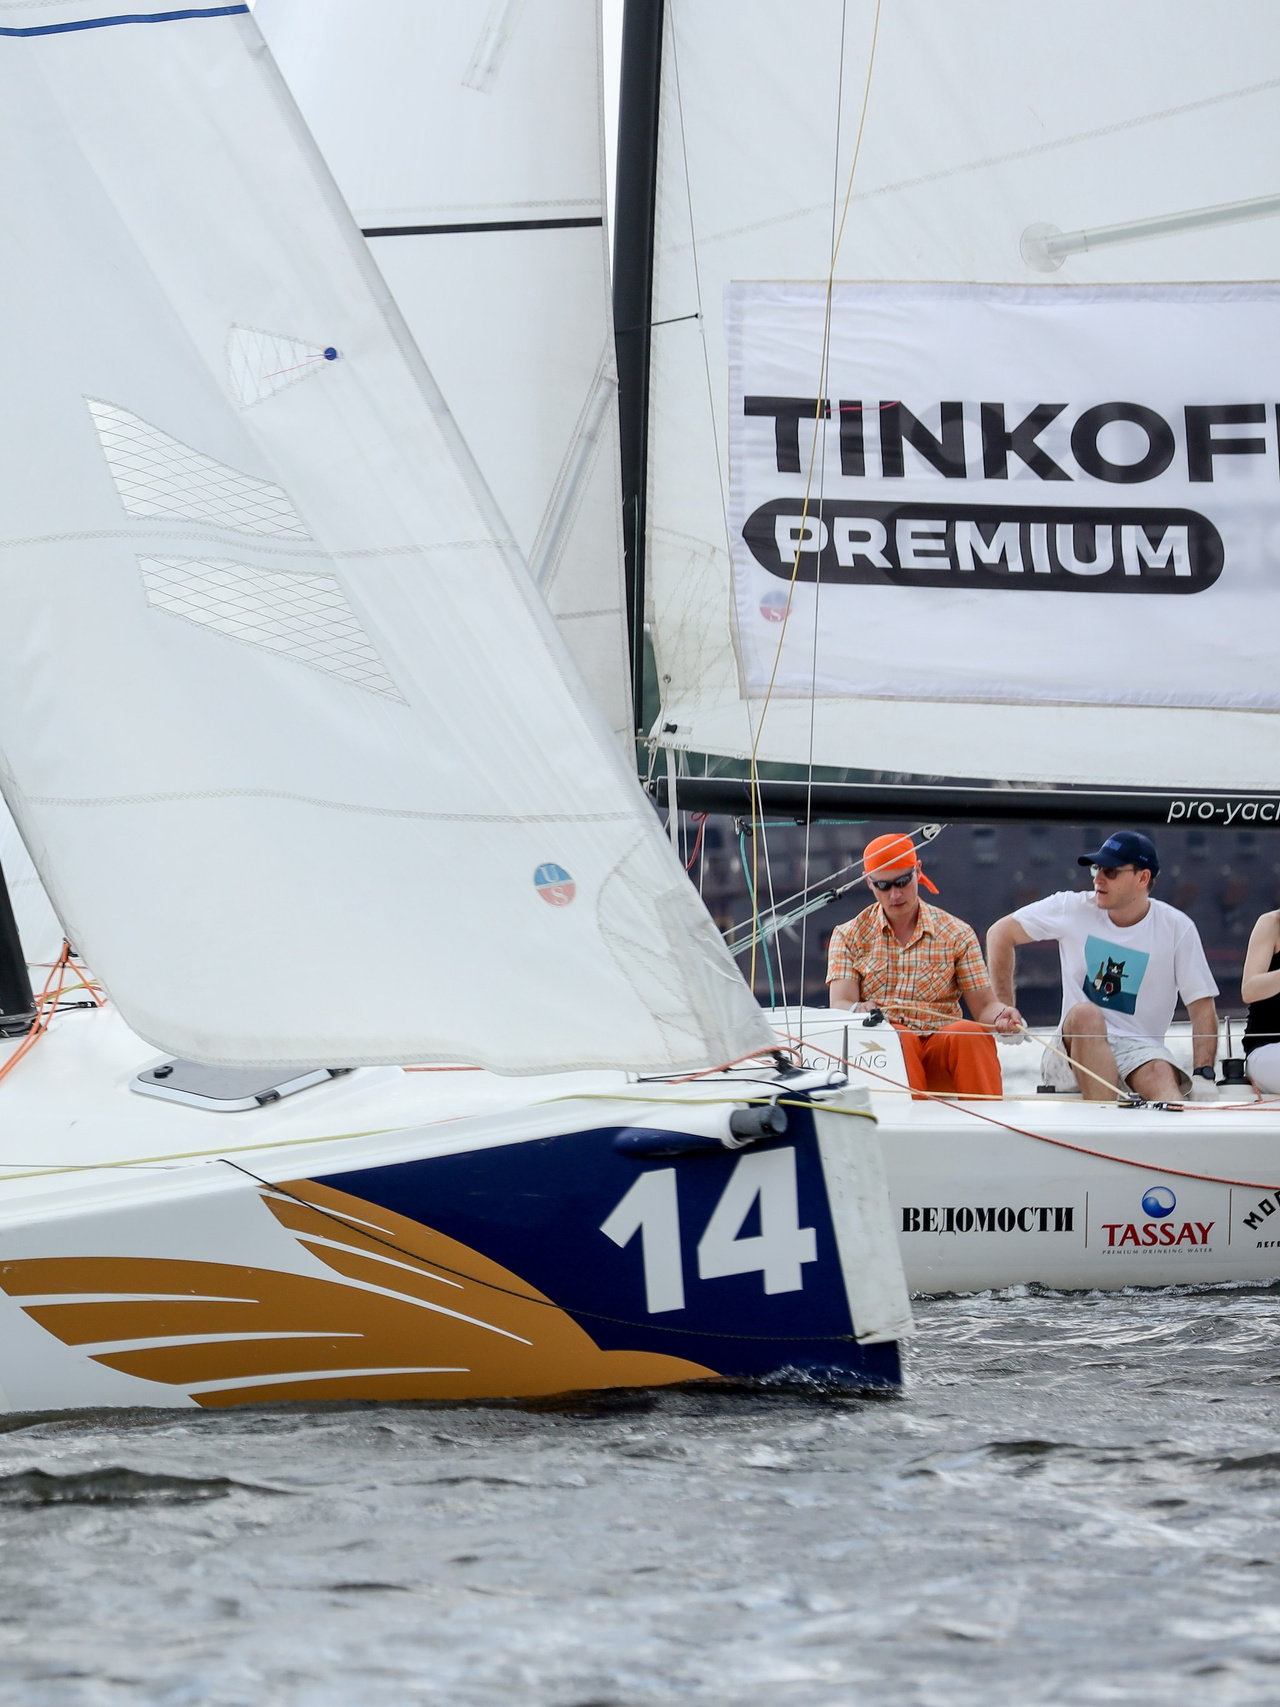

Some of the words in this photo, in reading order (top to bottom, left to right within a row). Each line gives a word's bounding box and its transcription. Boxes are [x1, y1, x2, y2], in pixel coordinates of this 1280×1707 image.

[744, 395, 1280, 484] TINKOF
[775, 514, 1192, 577] PREMIUM
[1167, 801, 1280, 825] pro-yac
[599, 1146, 818, 1314] 14
[901, 1206, 1075, 1236] ВЕДОМОСТИ
[1101, 1222, 1215, 1247] TASSAY
